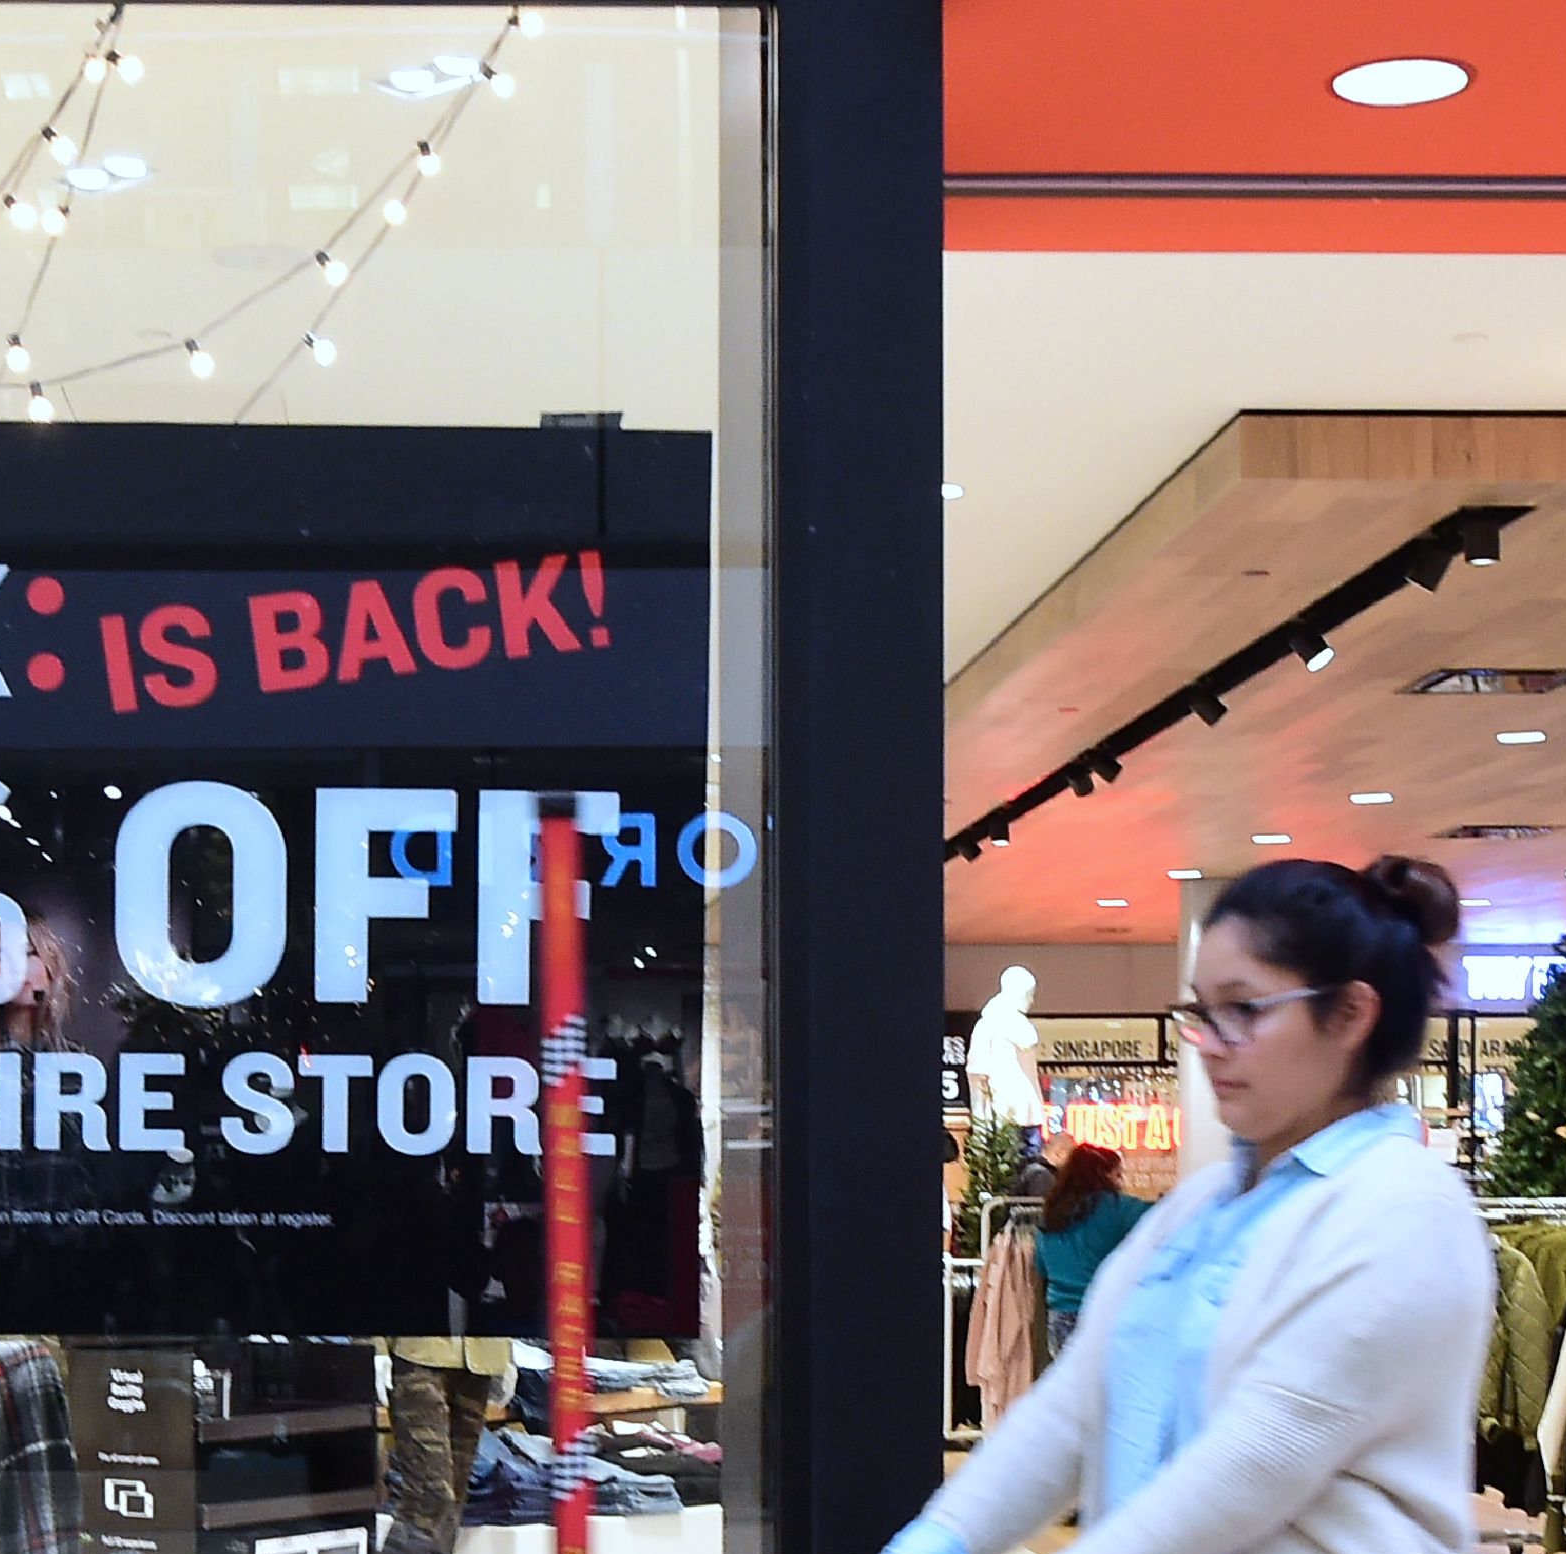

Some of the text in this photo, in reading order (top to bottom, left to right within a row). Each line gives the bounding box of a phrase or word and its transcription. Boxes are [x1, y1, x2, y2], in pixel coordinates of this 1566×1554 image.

[100, 605, 219, 713] IS
[248, 550, 612, 693] BACK!
[115, 780, 620, 1008] OFF
[1052, 1040, 1143, 1061] SINGAPORE
[220, 1051, 617, 1154] STORE
[12, 1208, 51, 1225] Items
[55, 1212, 70, 1225] or
[73, 1208, 100, 1225] Gift
[152, 1208, 216, 1226] Discount
[218, 1209, 258, 1226] taken
[260, 1210, 276, 1226] at
